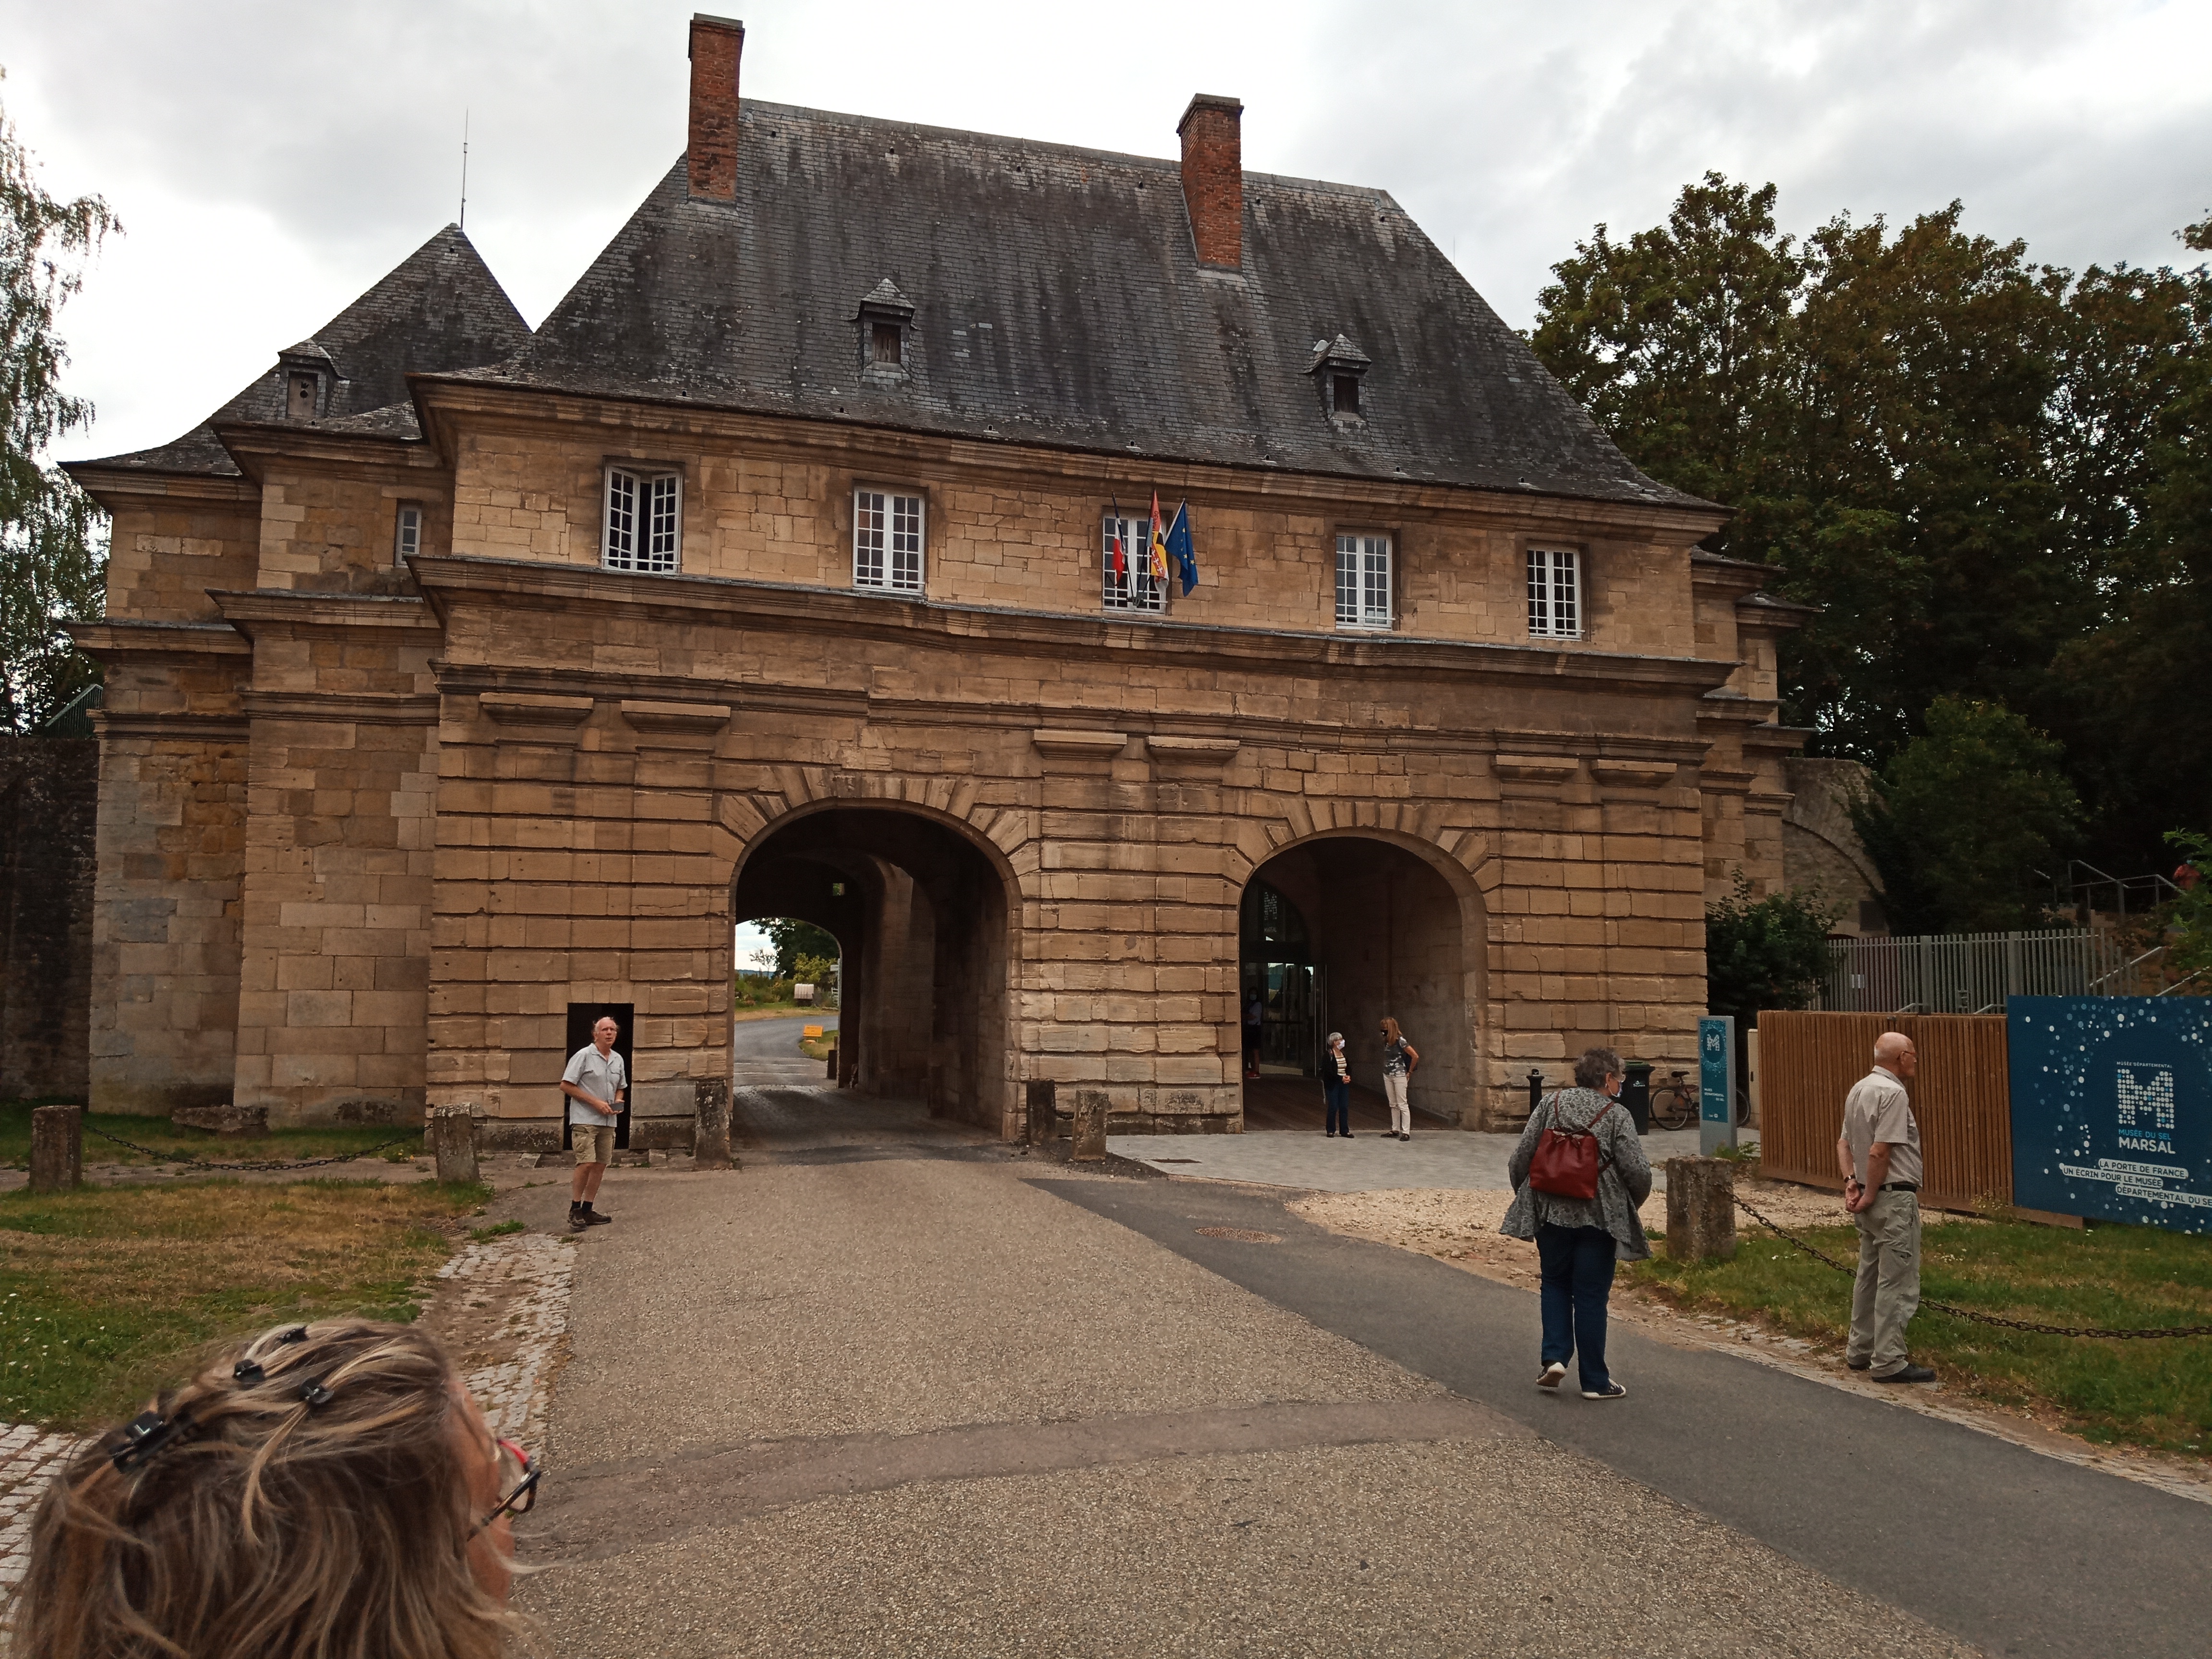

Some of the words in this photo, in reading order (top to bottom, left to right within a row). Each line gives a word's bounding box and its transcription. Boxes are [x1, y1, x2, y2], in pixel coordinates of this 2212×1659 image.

[1707, 1034, 1720, 1051] M
[2117, 1069, 2175, 1129] M
[2118, 1129, 2142, 1137] MUSÉE
[2118, 1136, 2176, 1154] MARSAL
[2076, 1167, 2099, 1178] ÉCRIN
[2101, 1172, 2121, 1181] POUR
[2136, 1177, 2162, 1187] MUSÉE
[2112, 1162, 2137, 1171] PORTE
[2152, 1167, 2188, 1178] FRANCE.
[2117, 1186, 2185, 1202] DÉPARTEMENTAL
[2188, 1196, 2200, 1204] DU
